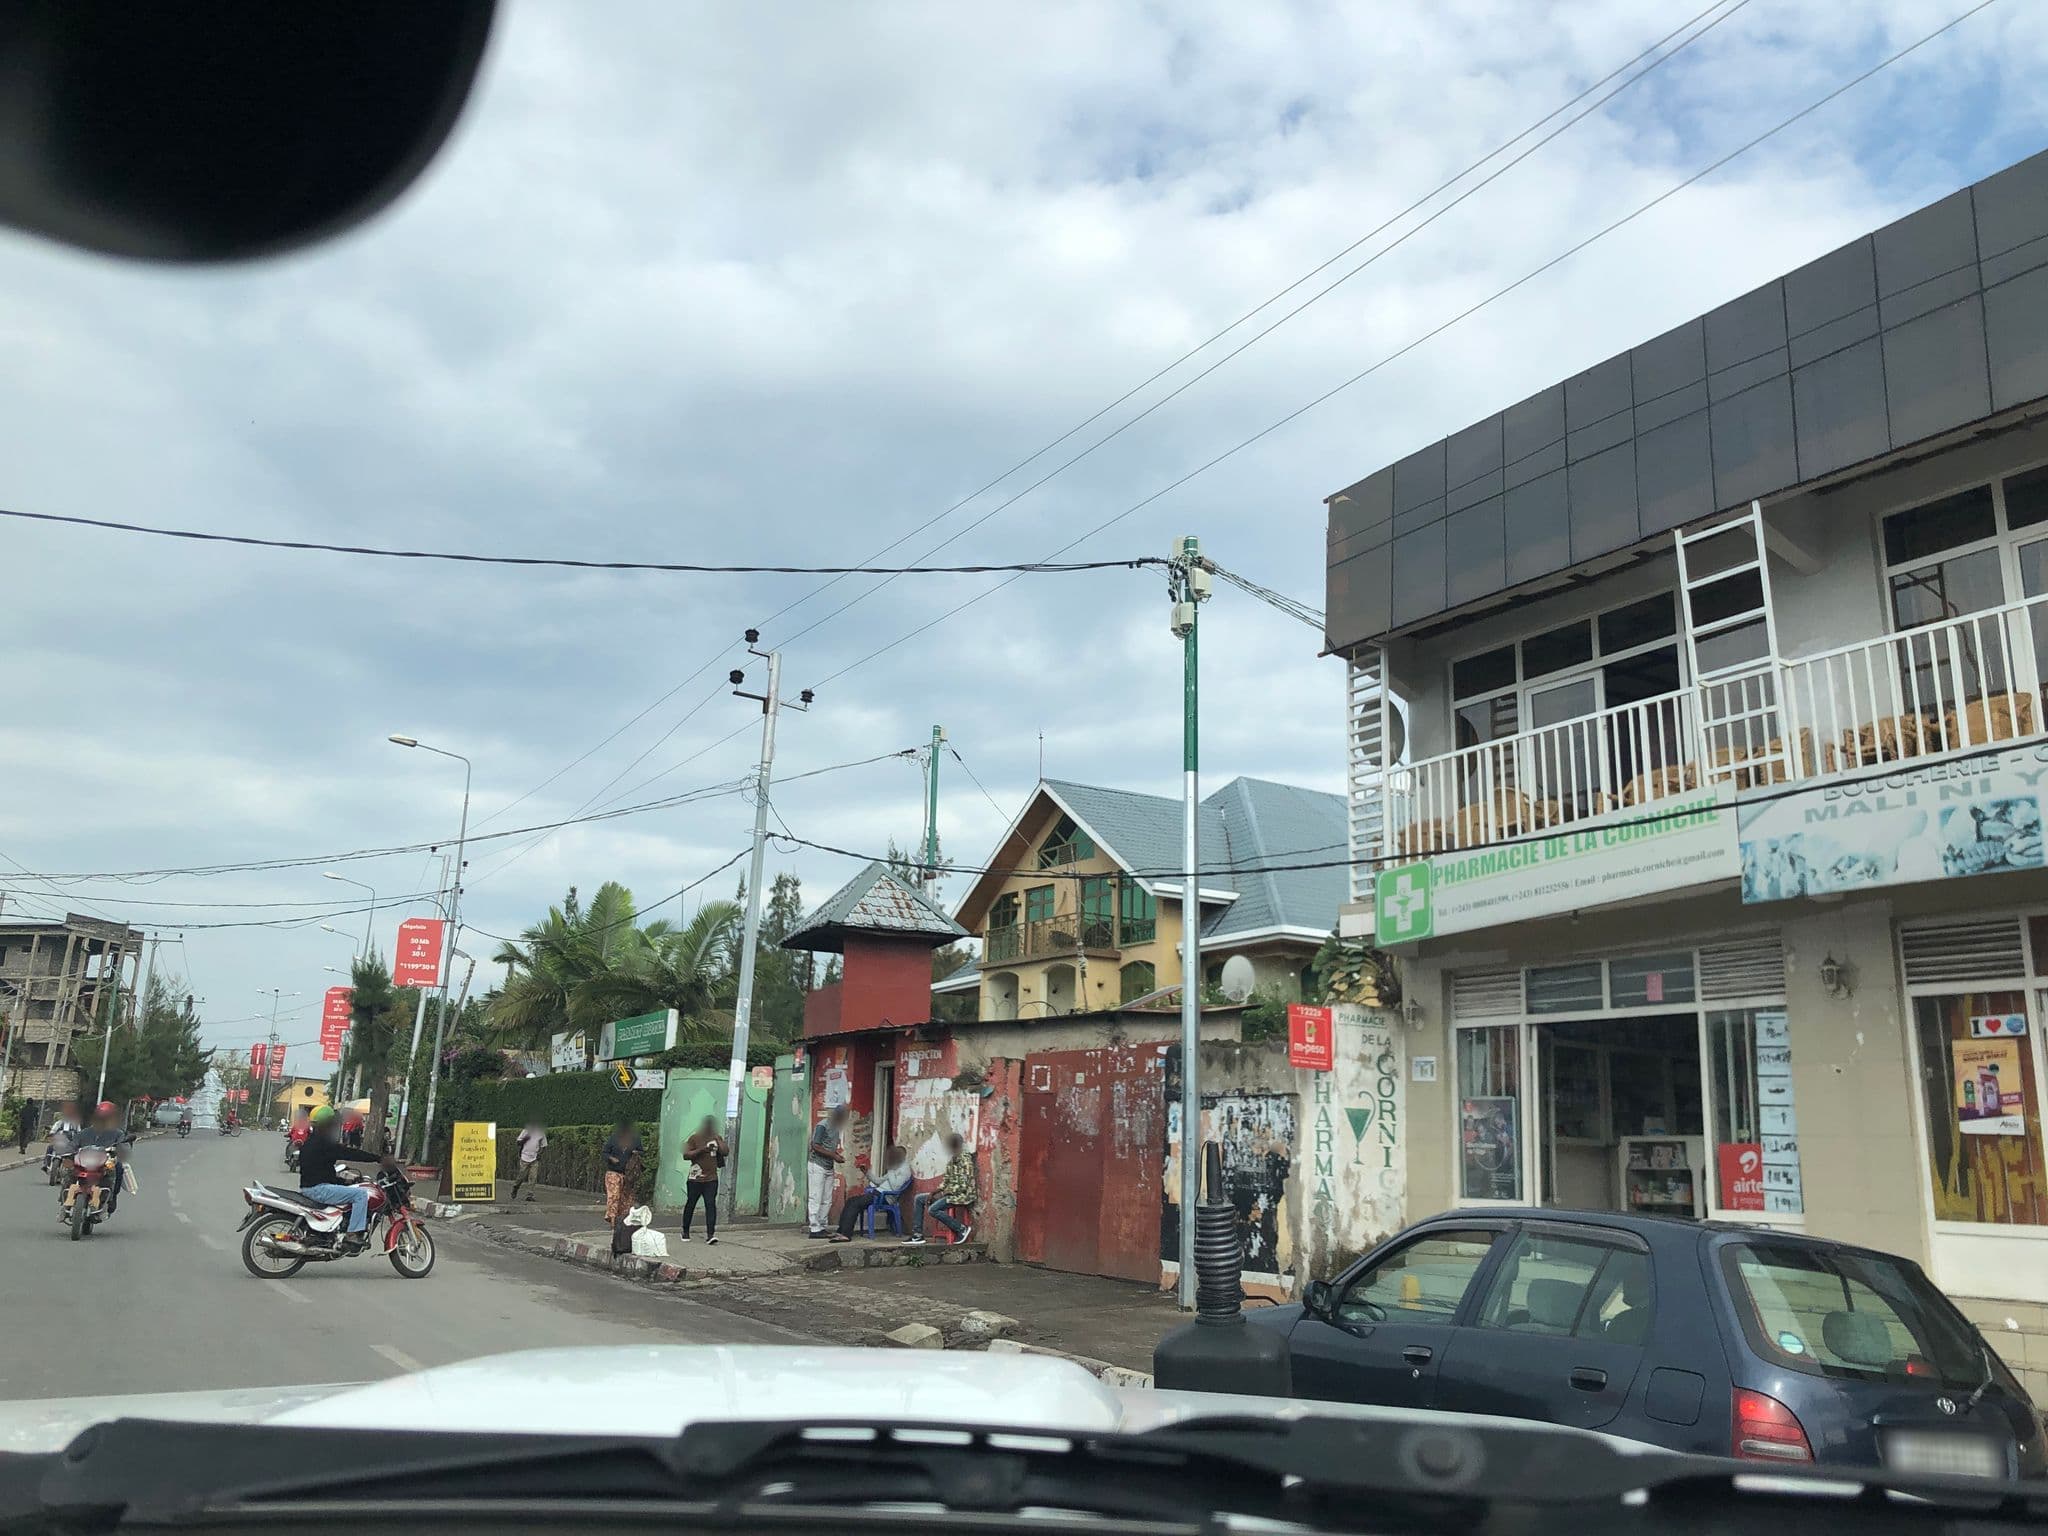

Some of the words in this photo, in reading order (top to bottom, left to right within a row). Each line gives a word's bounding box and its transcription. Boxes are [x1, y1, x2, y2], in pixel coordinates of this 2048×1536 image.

[1805, 791, 1919, 824] MALI
[1938, 777, 1992, 801] NI
[1432, 841, 1540, 888] PHARMACIE
[1545, 834, 1570, 860] DE
[1573, 829, 1599, 853] LA
[1602, 796, 1720, 847] CORNICHE
[1338, 1012, 1387, 1027] PHARMACIE
[1361, 1033, 1375, 1046] DE
[1376, 1035, 1392, 1047] LA
